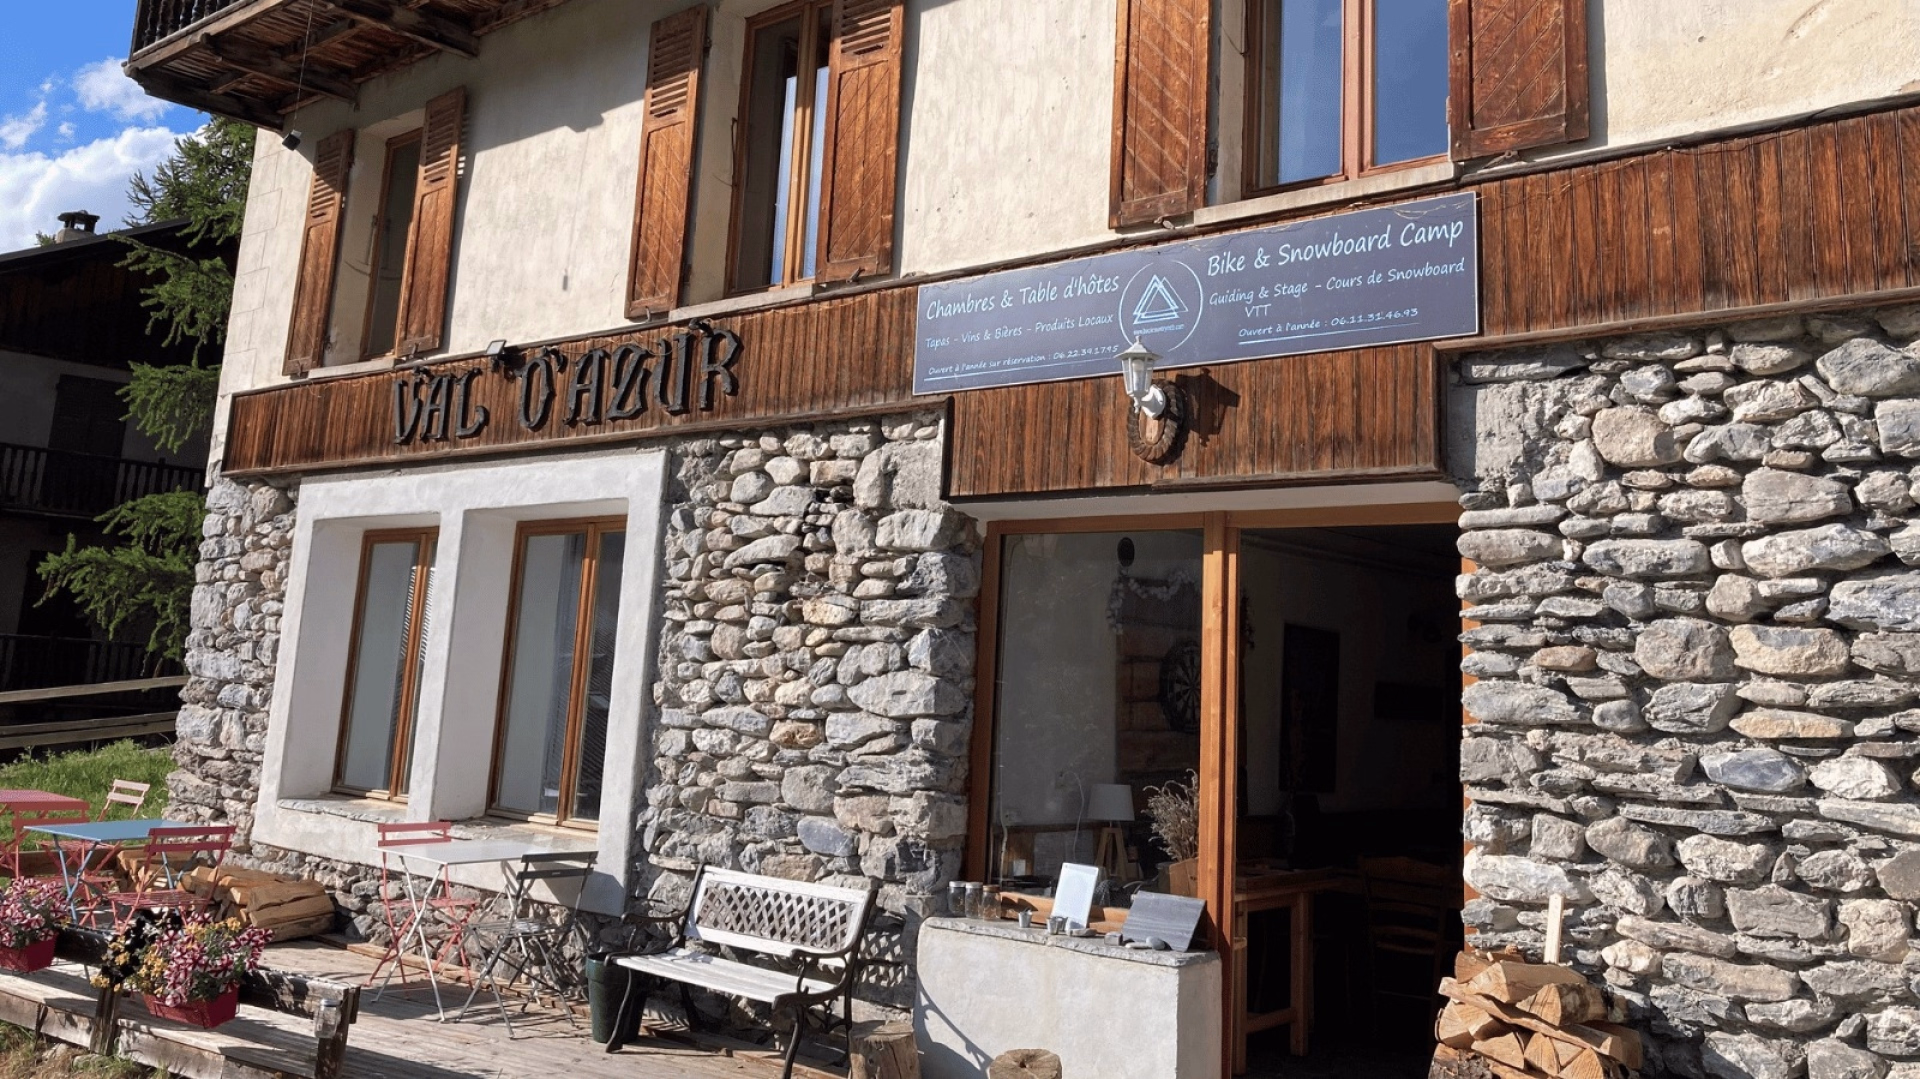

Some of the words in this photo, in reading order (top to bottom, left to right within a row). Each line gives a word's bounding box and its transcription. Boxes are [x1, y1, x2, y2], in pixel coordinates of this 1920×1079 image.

[1207, 251, 1246, 277] Bike
[1253, 246, 1271, 270] &
[1278, 224, 1392, 266] Snowboard
[1399, 220, 1464, 248] Camp
[926, 293, 996, 320] Chambres
[1000, 290, 1013, 308] &
[1019, 281, 1058, 305] Table
[1063, 274, 1120, 299] d'hôtes
[1209, 288, 1254, 306] Guiding
[1258, 286, 1270, 299] &
[1273, 280, 1308, 299] Stage
[1326, 273, 1363, 291] Cours
[1367, 269, 1383, 285] de
[1387, 257, 1465, 281] Snowboard
[1238, 327, 1273, 338] Ouvert
[1276, 324, 1282, 333] à
[1285, 320, 1321, 331] l'année
[1330, 308, 1418, 327] 06.11.31.46.93
[1244, 304, 1272, 318] VTT
[925, 337, 951, 351] Tapas
[961, 332, 980, 343] Vins
[983, 329, 992, 340] &
[994, 327, 1023, 340] Bières
[1035, 318, 1075, 333] Produits
[1078, 314, 1114, 327] Locaux
[989, 359, 1001, 368] sur
[393, 367, 489, 445] VAL
